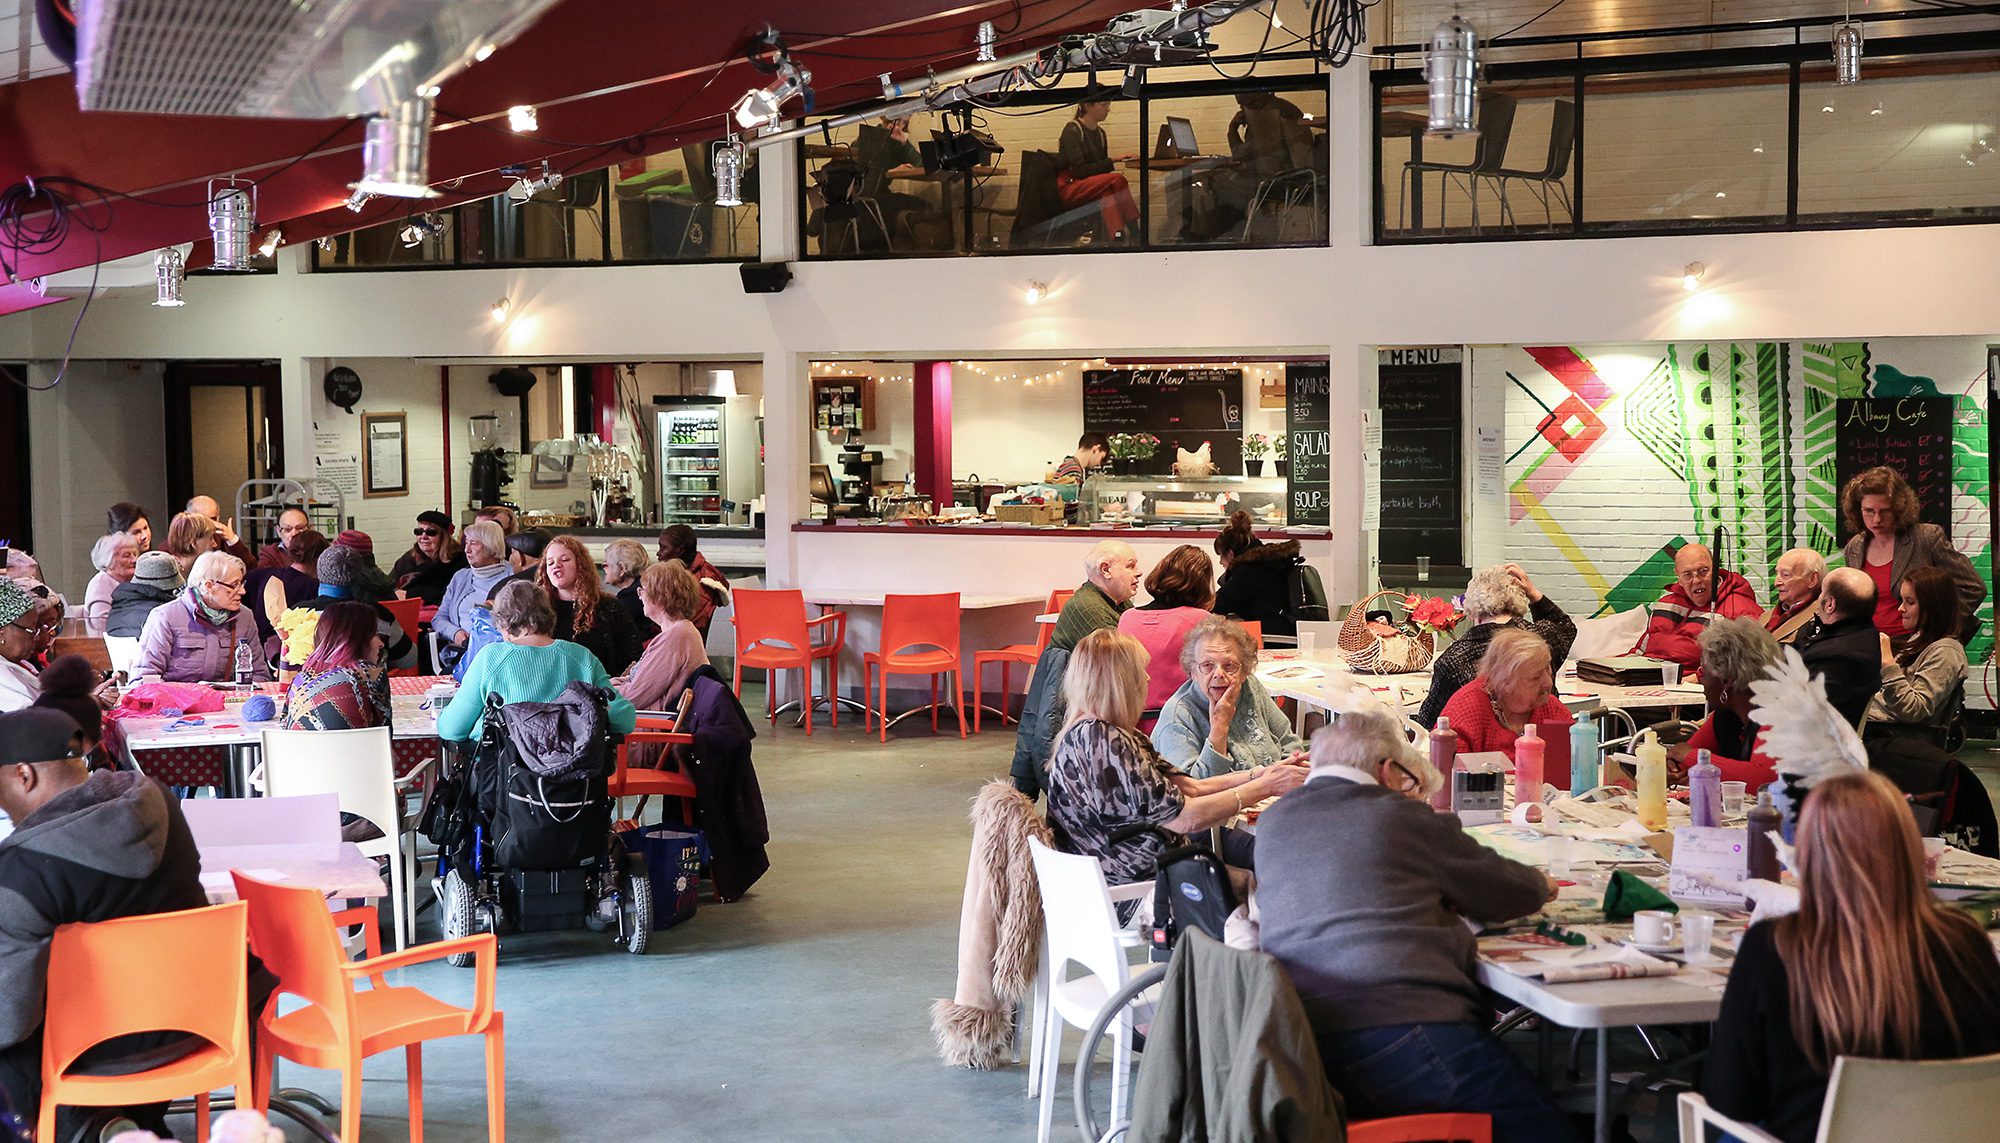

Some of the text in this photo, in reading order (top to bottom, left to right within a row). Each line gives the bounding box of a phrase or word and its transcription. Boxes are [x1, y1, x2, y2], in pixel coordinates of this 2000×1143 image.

[1391, 349, 1440, 364] MENU
[1130, 370, 1153, 385] Food
[1156, 371, 1184, 385] Menu
[1295, 377, 1329, 394] MAINS
[1844, 400, 1890, 432] Albany
[1295, 491, 1321, 508] SOUP
[682, 846, 698, 860] IT'S
